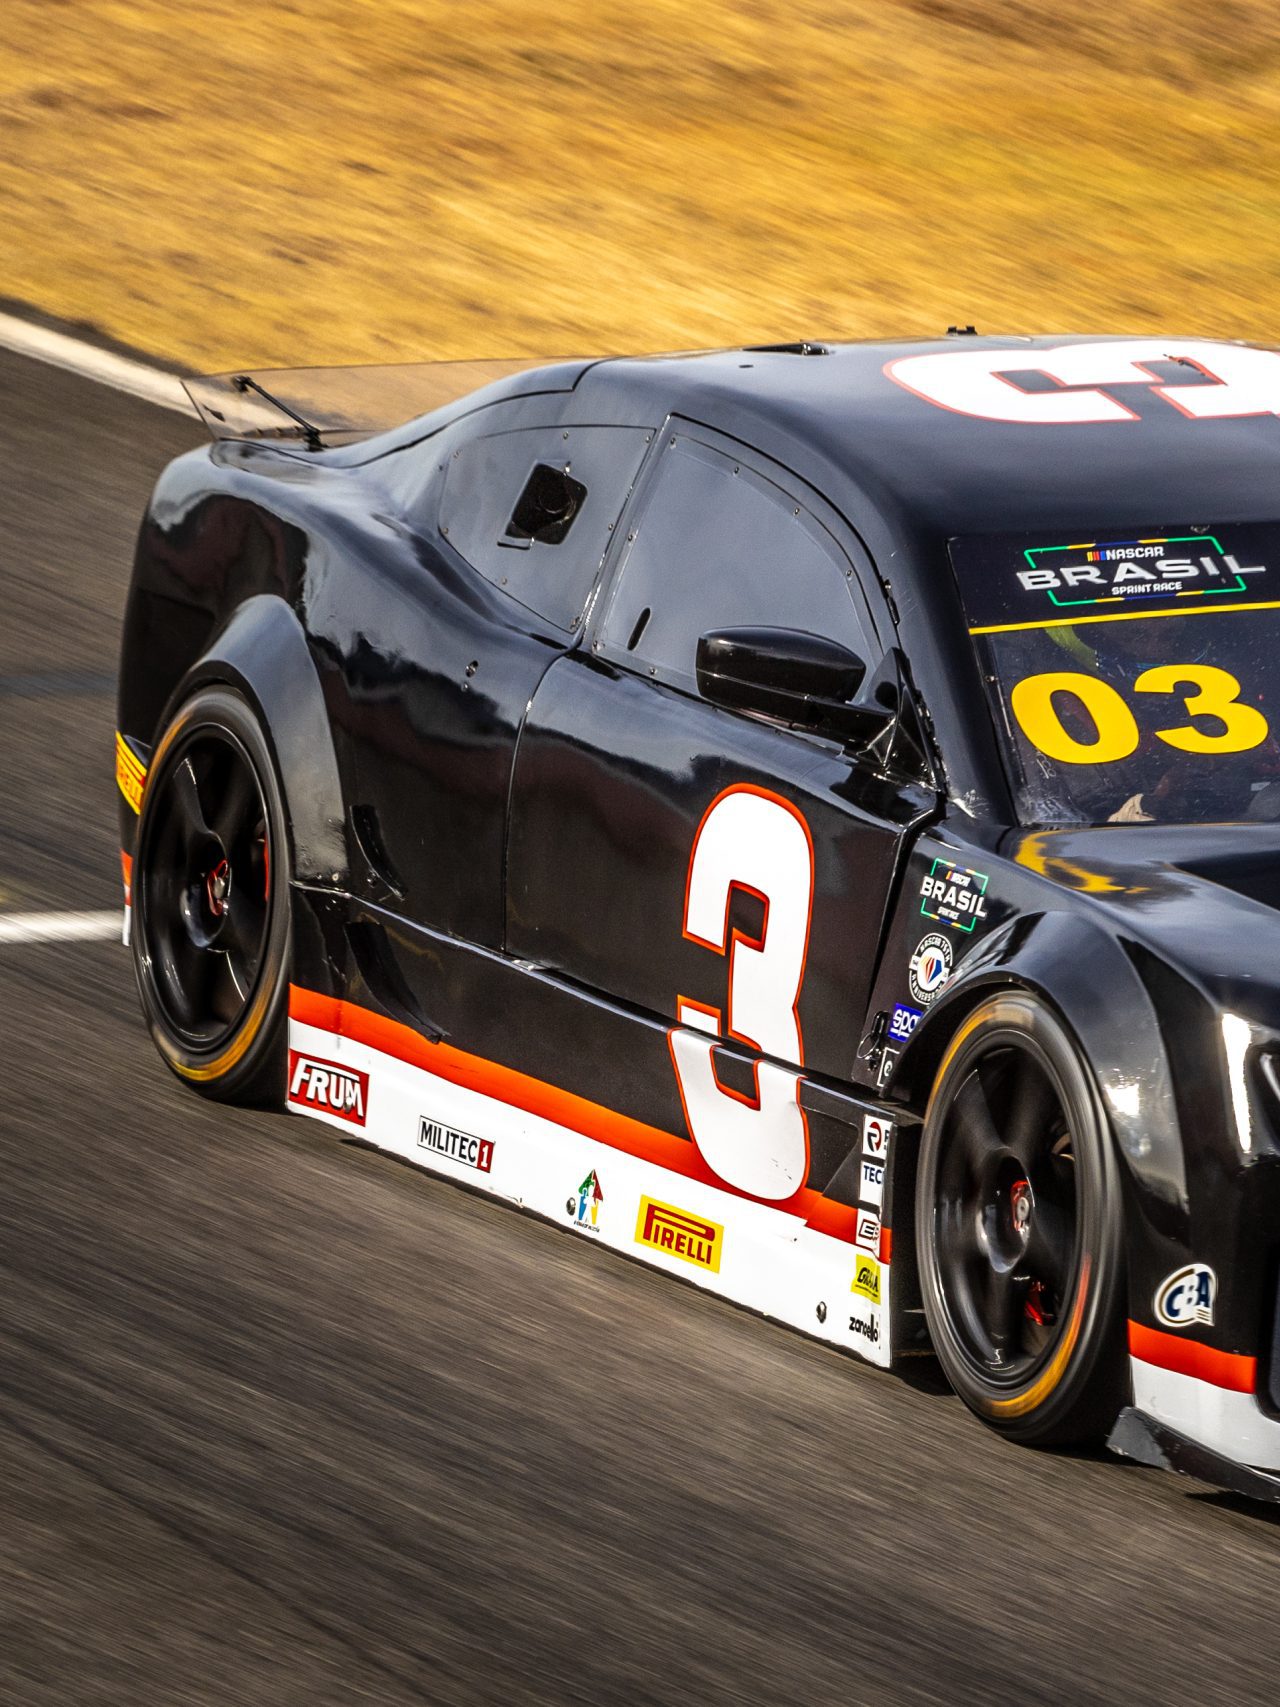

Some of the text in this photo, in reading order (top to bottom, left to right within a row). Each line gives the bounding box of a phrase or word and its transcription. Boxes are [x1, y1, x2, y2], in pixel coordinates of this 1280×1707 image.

[1016, 555, 1266, 591] BRASIL
[1105, 546, 1165, 561] NASCAR
[1111, 581, 1183, 596] SPRINT RACE
[1011, 664, 1269, 765] 03
[920, 875, 988, 918] BRASIL
[667, 782, 815, 1201] 3
[290, 1057, 364, 1117] FRUM
[420, 1120, 478, 1163] MILITEC
[643, 1203, 715, 1265] PIRELLI
